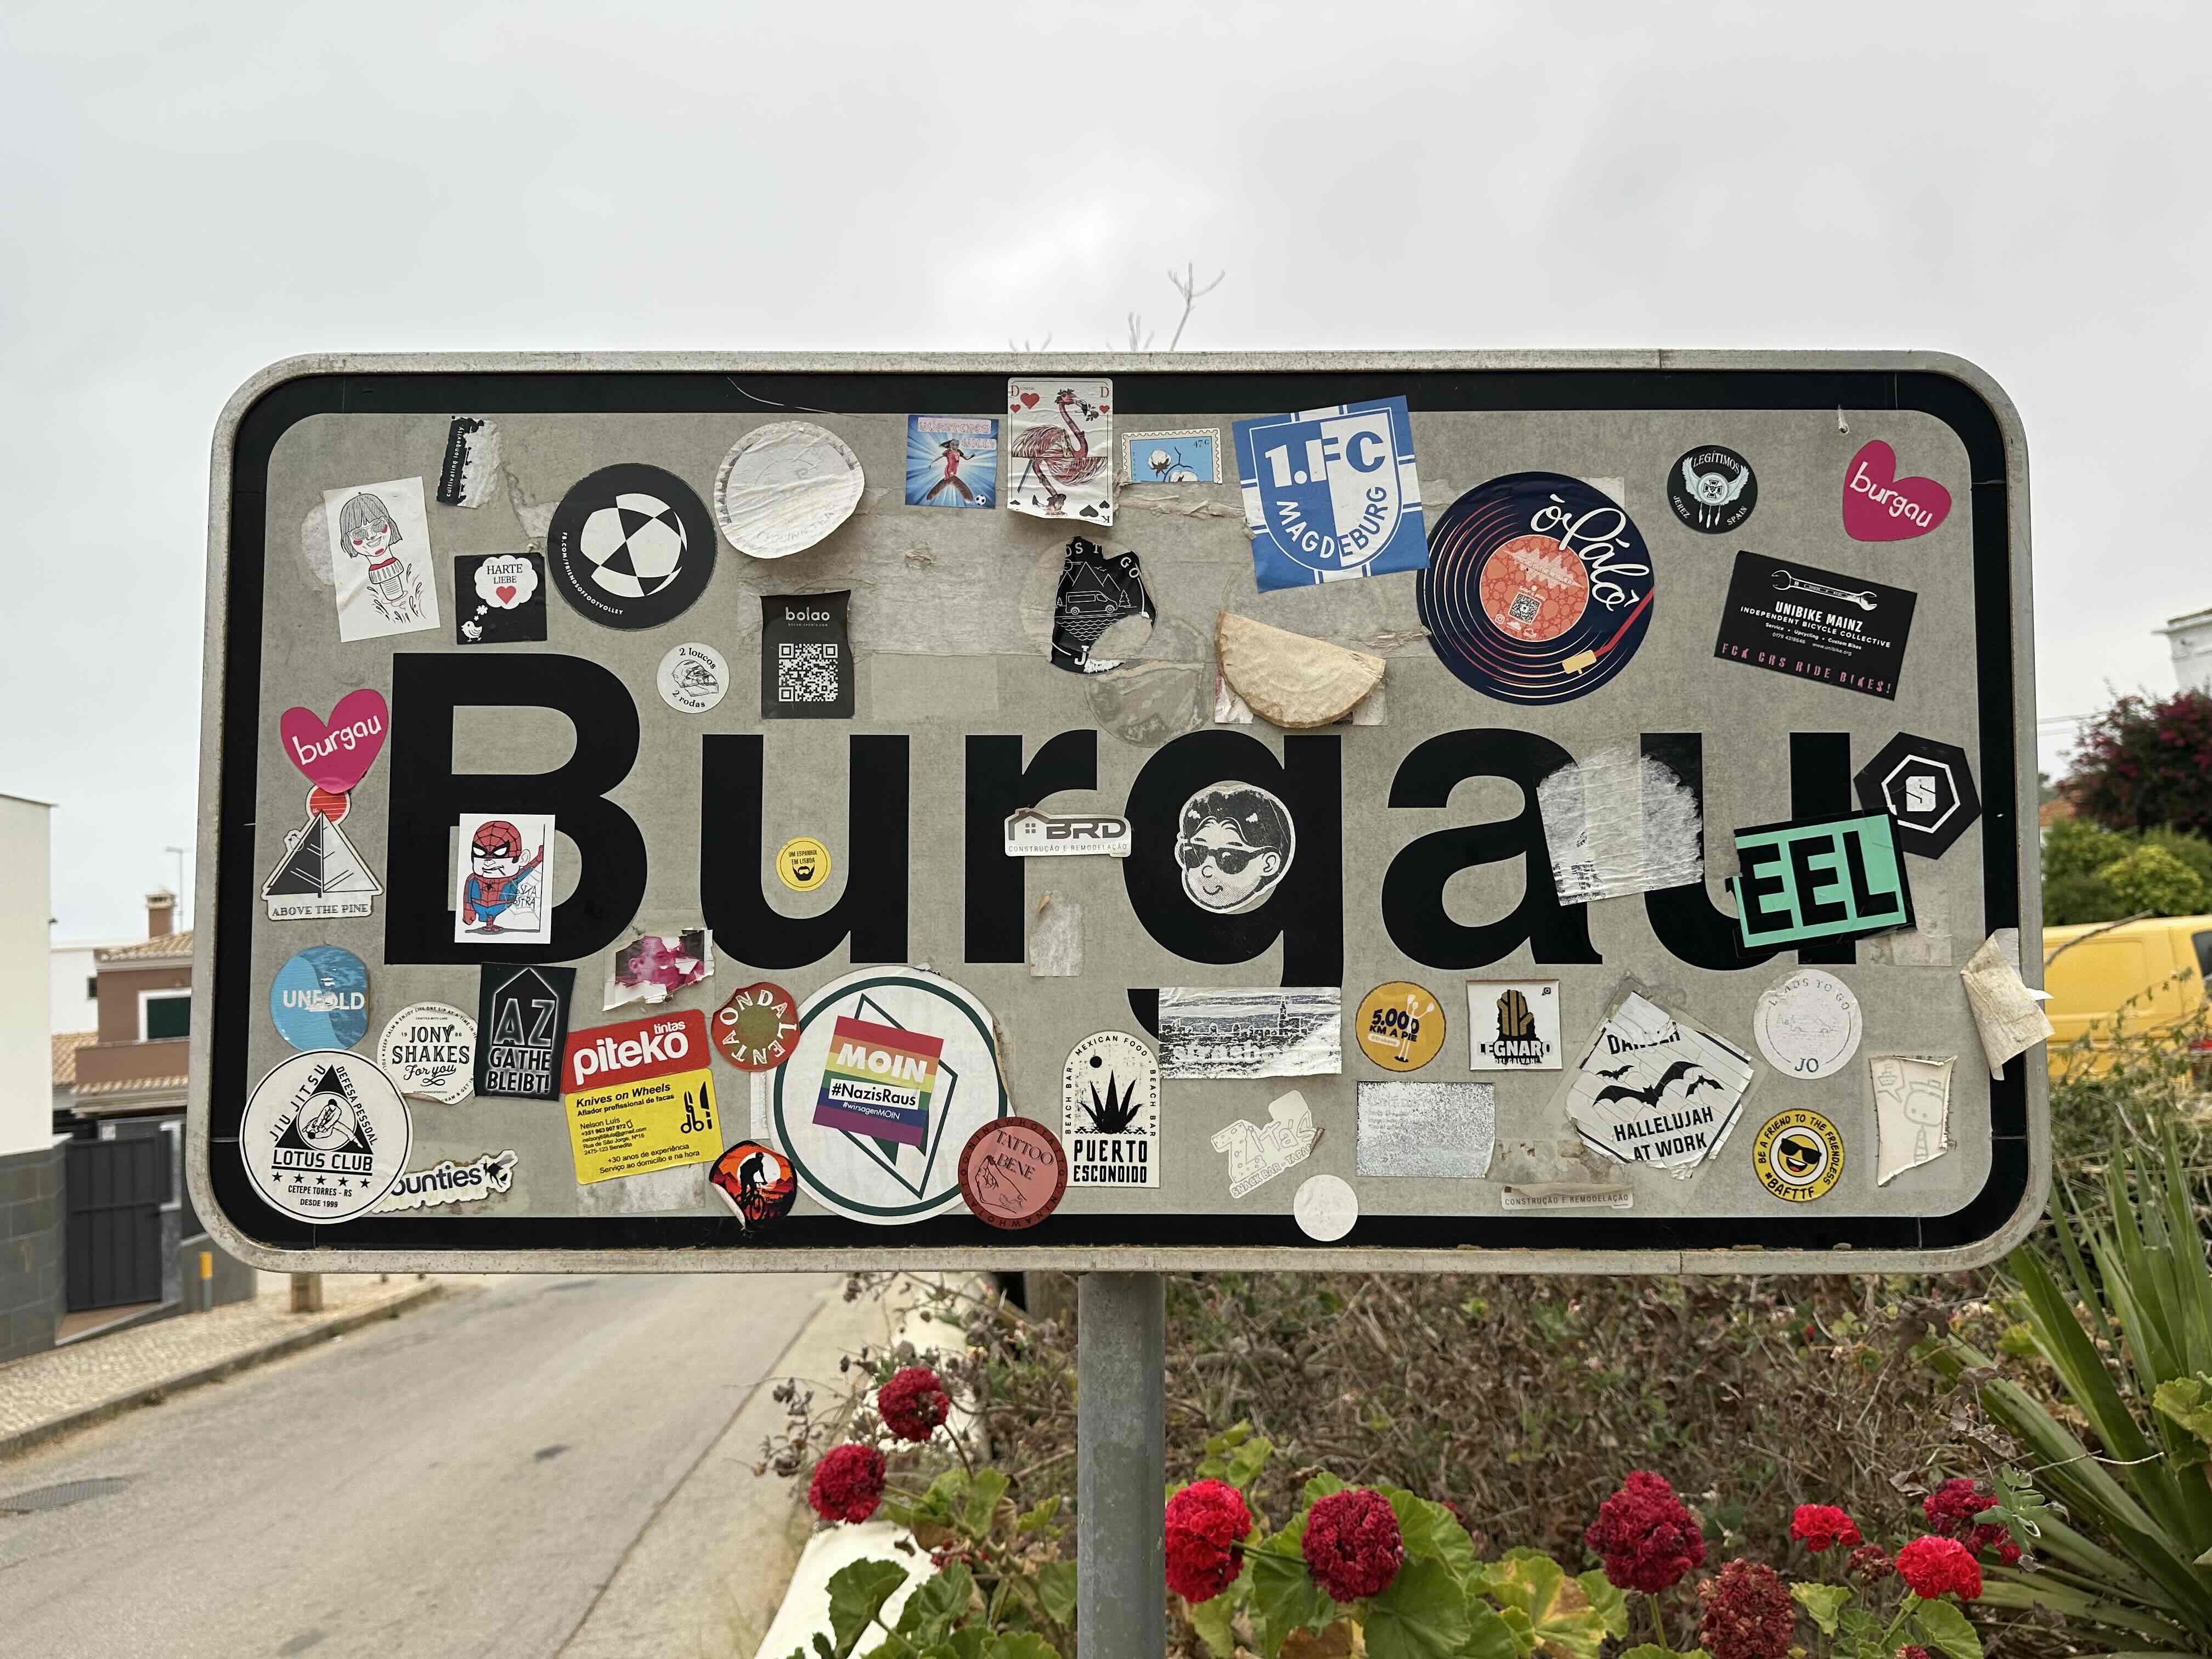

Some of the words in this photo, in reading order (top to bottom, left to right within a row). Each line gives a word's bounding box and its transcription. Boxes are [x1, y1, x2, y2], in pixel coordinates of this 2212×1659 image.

[446, 460, 459, 497] cultivating
[453, 426, 465, 459] longevity
[1693, 450, 1740, 475] LEGÍTIMOS
[1849, 461, 1933, 527] burgau
[1276, 486, 1389, 558] MAGDEBURG
[1673, 495, 1690, 519] JEREZ
[1726, 505, 1747, 526] SPAIN
[487, 563, 523, 574] HARTE
[493, 575, 517, 584] LIEBE
[785, 606, 830, 620] bolao
[1775, 601, 1823, 623] UNIBIKE
[1826, 613, 1864, 633] MAINZ
[1740, 605, 1799, 626] INDEPENDENT
[1802, 621, 1837, 635] BICYCLE
[1840, 630, 1892, 648] COLLECTIVE
[1765, 622, 1785, 631] Service
[1795, 662, 1831, 679] RIDE
[679, 696, 706, 708] rodas
[291, 715, 382, 766] burgau
[272, 905, 313, 917] ABOVE
[314, 905, 338, 915] THE
[342, 903, 369, 914] PINE
[409, 1024, 455, 1043] JONY
[493, 997, 556, 1047] AZ
[653, 1020, 686, 1035] tintas
[1369, 1025, 1387, 1035] KM
[1389, 1028, 1398, 1037] A
[1401, 1031, 1418, 1042] PIE
[1372, 1008, 1420, 1035] 5.000
[392, 1045, 470, 1064] SHAKES
[1075, 1035, 1119, 1057] MEXICAN
[1124, 1037, 1148, 1057] FOOD
[489, 1047, 552, 1071] GATHE
[573, 1031, 689, 1086] piteko
[836, 1042, 928, 1084] MOIN
[403, 1064, 431, 1081] For
[487, 1070, 550, 1094] BLEIBT!
[269, 1114, 291, 1142] JIU
[290, 1064, 326, 1113] JITSU
[335, 1065, 357, 1103] DEFESA
[353, 1103, 378, 1146] PESSOAL
[576, 1094, 612, 1108] Knives
[615, 1092, 629, 1101] on
[631, 1083, 671, 1098] Wheels
[831, 1082, 916, 1106] #NazisRaus
[577, 1107, 602, 1117] Afiador
[603, 1100, 645, 1113] profissional
[843, 1101, 901, 1120] #wirsagenMOIN
[579, 1120, 604, 1130] Nelson
[1613, 1106, 1714, 1142] HALLELUJAH
[622, 1152, 639, 1161] anos
[995, 1129, 1054, 1166] TATTOO
[1073, 1139, 1148, 1163] PUERTO
[1633, 1144, 1651, 1161] AT
[1654, 1132, 1708, 1158] WORK
[1758, 1151, 1767, 1164] BE
[1764, 1115, 1791, 1139] FRIEND
[1795, 1114, 1806, 1122] TO
[1810, 1116, 1827, 1131] THE
[1823, 1131, 1840, 1185] FRIENDLESS
[273, 1149, 326, 1168] LOTUS
[331, 1154, 374, 1171] CLUB
[599, 1164, 625, 1174] Serviço
[684, 1149, 700, 1158] hora
[996, 1153, 1036, 1181] BENE
[391, 1164, 483, 1196] ounties
[1073, 1165, 1148, 1184] ESCONDIDO
[1764, 1171, 1815, 1200] #BAFTTF
[288, 1185, 311, 1194] CETEPE
[313, 1186, 337, 1197] TORRES
[343, 1188, 352, 1197] RS
[300, 1198, 321, 1207] DESDE
[322, 1200, 338, 1208] 1999
[1504, 1195, 1559, 1206] CONSTRUÇÃO
[1569, 1193, 1629, 1205] REMODELAÇÃO
